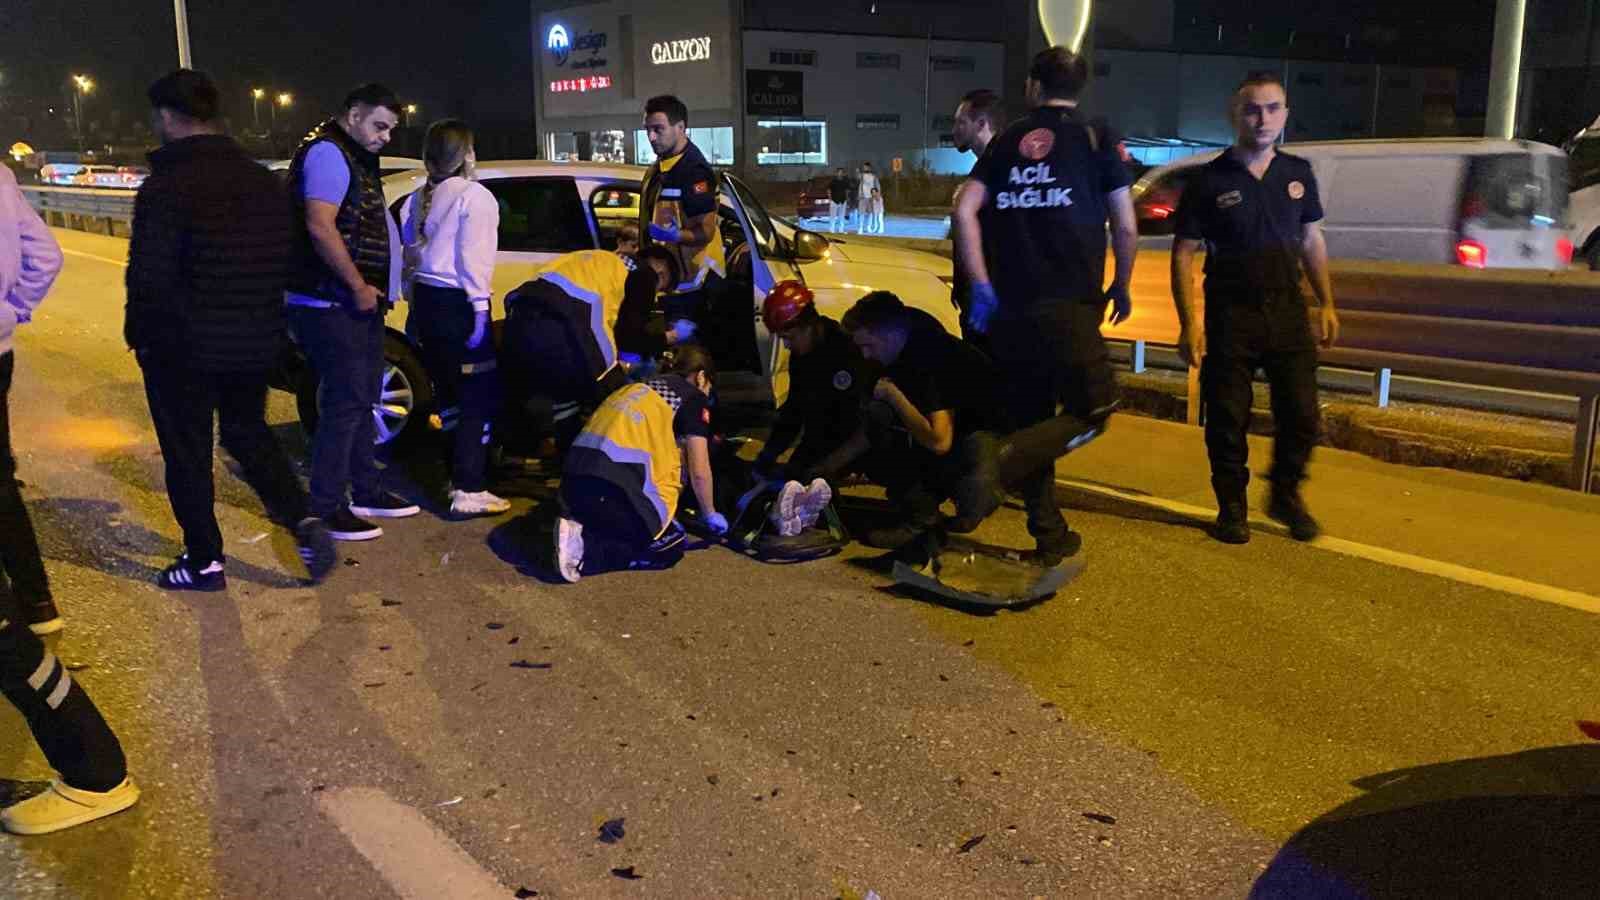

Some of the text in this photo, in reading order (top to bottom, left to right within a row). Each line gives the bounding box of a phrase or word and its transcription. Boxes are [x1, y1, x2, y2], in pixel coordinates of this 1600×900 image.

[651, 36, 711, 65] CALYON
[1008, 162, 1056, 185] ACİL
[996, 187, 1072, 209] SAĞLIK
